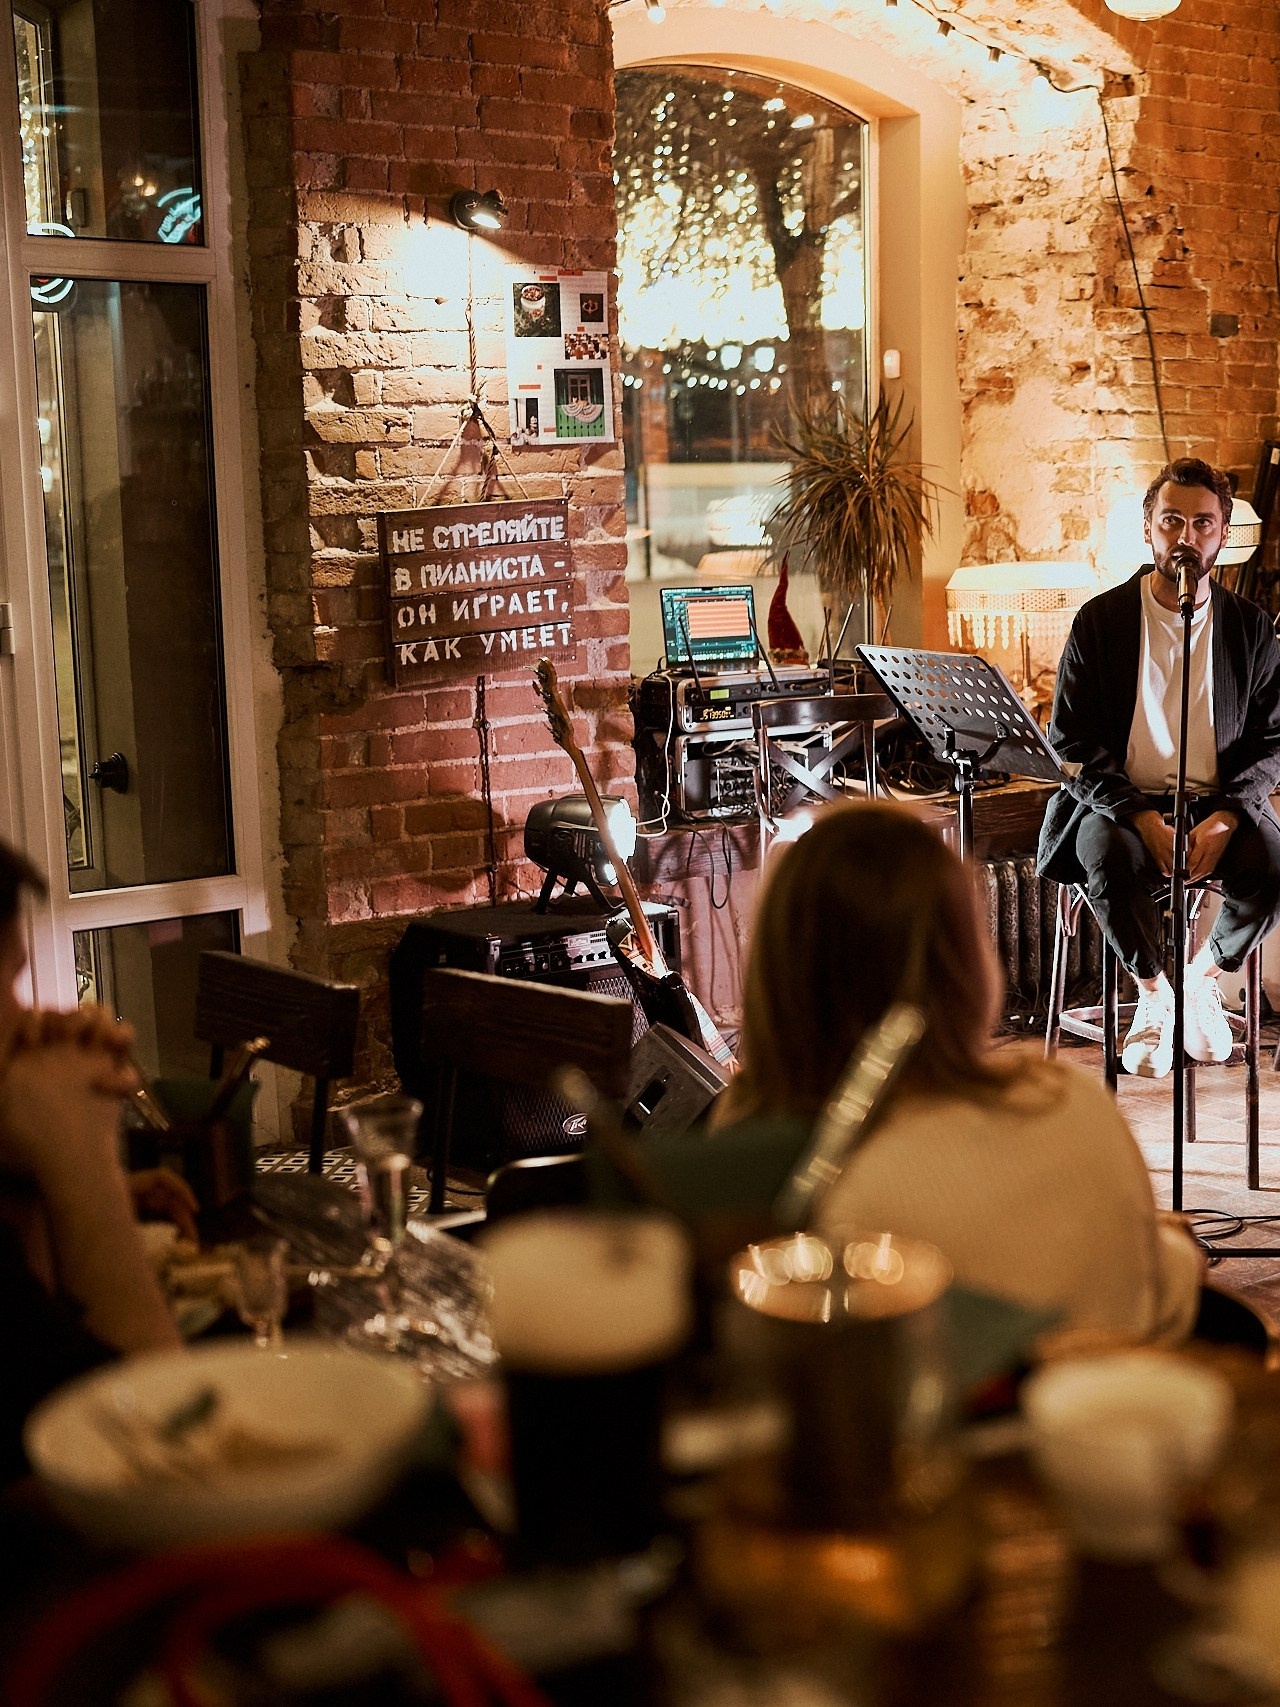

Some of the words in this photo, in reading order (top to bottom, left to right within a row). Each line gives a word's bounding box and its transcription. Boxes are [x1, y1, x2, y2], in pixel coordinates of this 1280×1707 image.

[393, 528, 424, 553] НЕ
[433, 514, 565, 549] СТРЕЛЯЙТЕ
[395, 567, 412, 591] В
[421, 554, 545, 589] ПИАНИСТА
[397, 603, 436, 629] ОН
[453, 588, 569, 622] ИГРАЕТ,
[400, 637, 461, 666] КАК
[479, 622, 571, 655] УМЕЕТ
